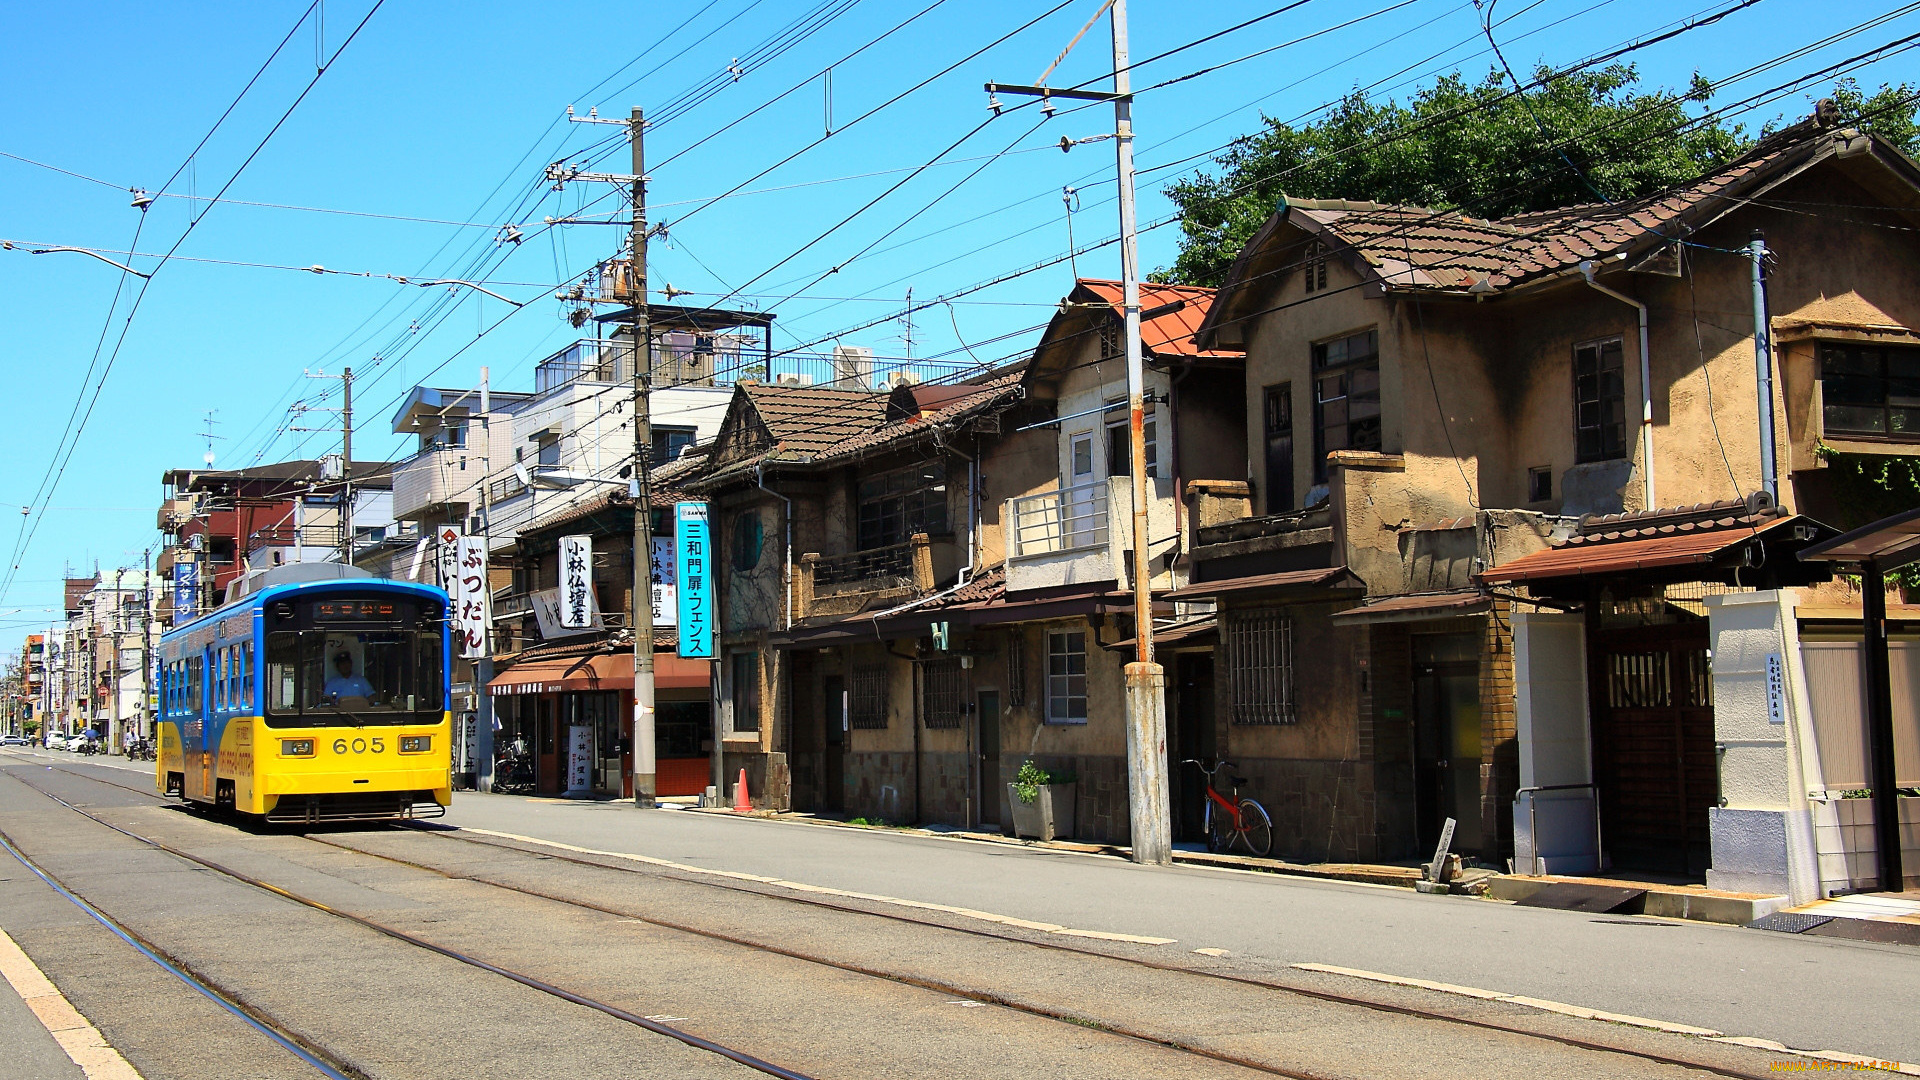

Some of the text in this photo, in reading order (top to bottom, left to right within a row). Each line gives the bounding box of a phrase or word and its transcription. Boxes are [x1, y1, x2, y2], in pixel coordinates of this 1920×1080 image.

[462, 548, 482, 649] ぶつだん
[568, 541, 587, 624] 小林仏壇店
[686, 524, 704, 653] 三和門扉・フェンス
[333, 737, 385, 755] 605
